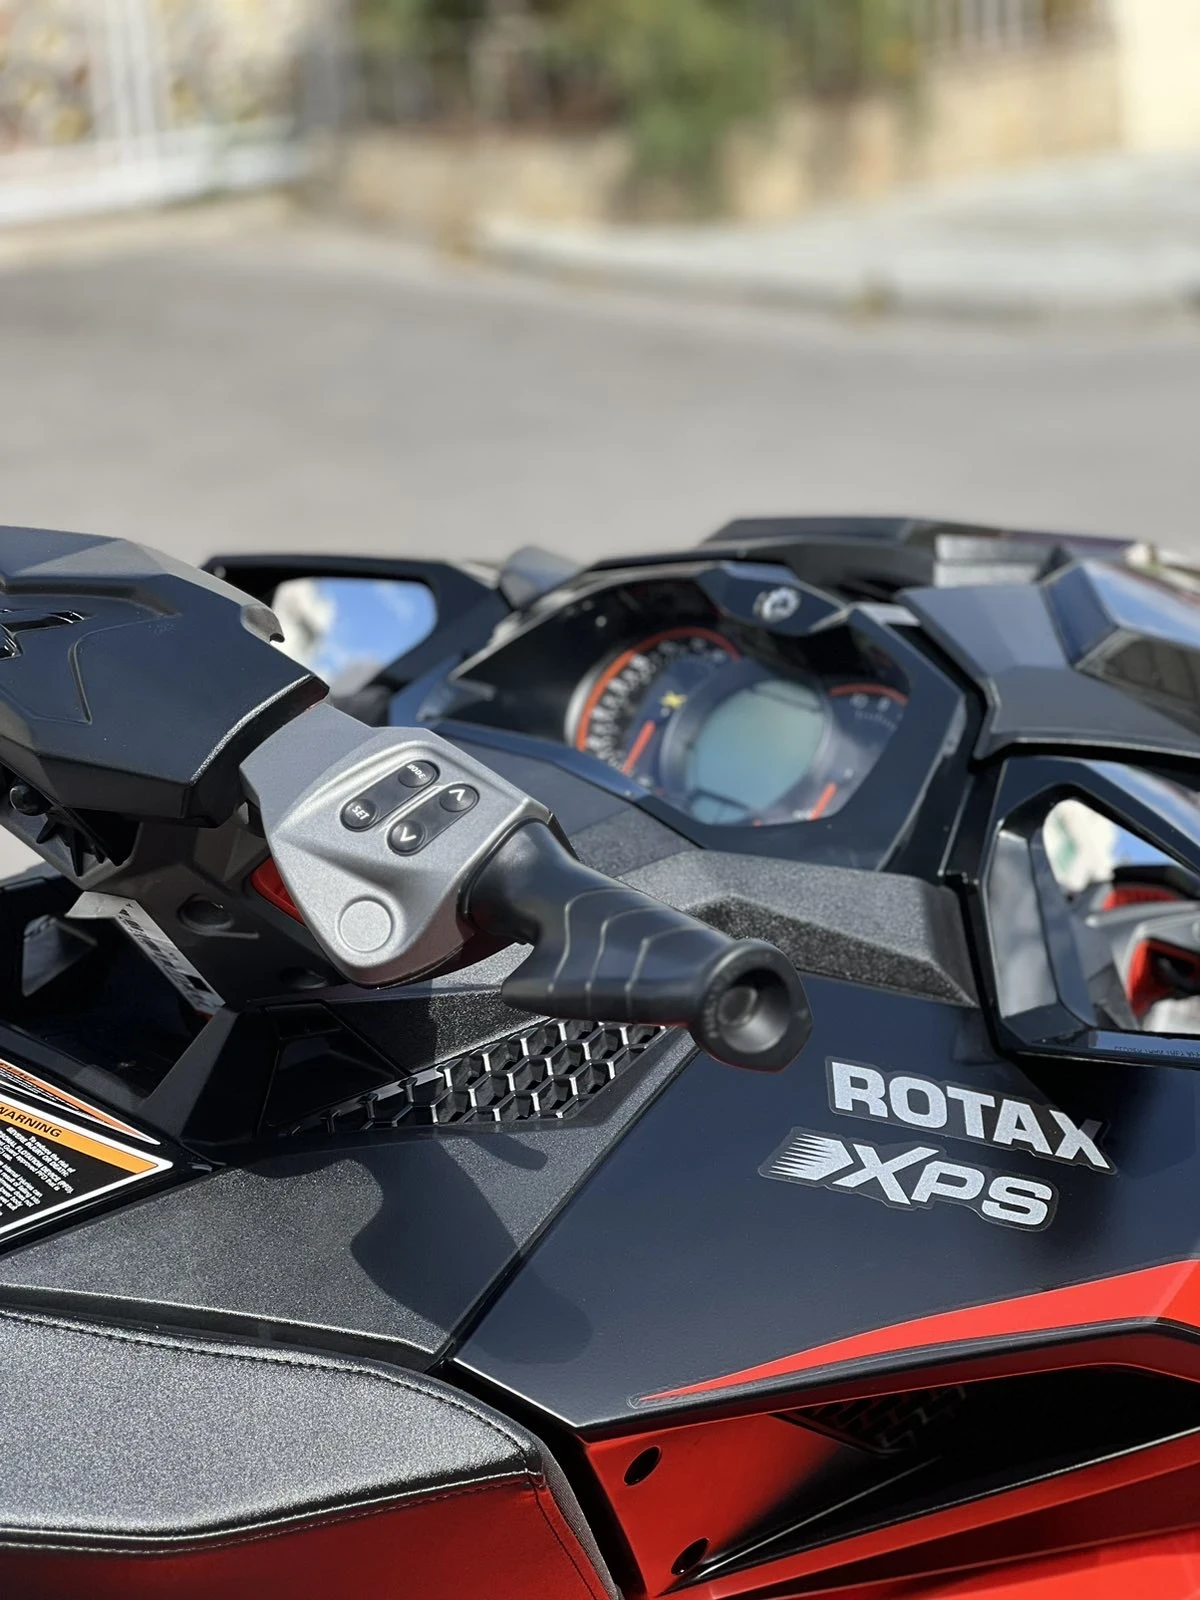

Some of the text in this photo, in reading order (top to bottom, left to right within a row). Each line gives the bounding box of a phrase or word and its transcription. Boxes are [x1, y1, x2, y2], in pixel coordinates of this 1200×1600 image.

[407, 763, 428, 781] MODE
[351, 805, 371, 821] SET
[831, 1060, 1111, 1170] ROTAX
[831, 1143, 1053, 1227] XPS
